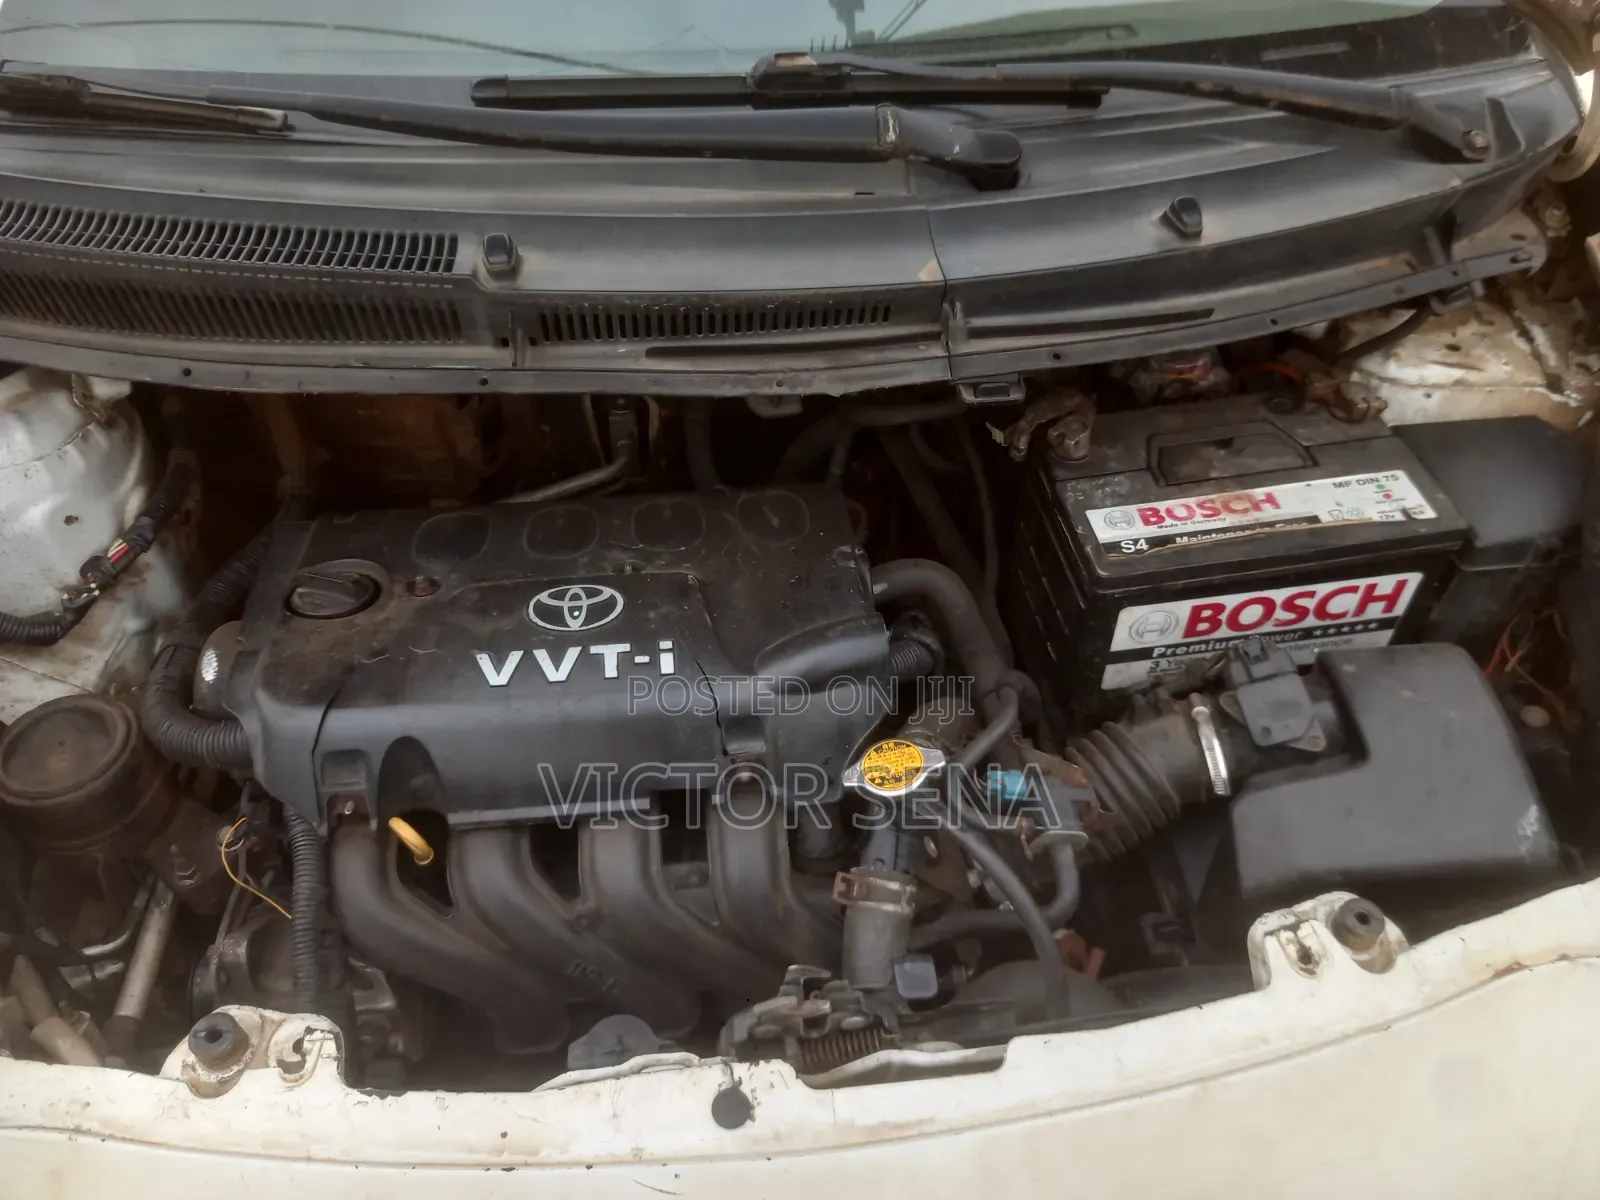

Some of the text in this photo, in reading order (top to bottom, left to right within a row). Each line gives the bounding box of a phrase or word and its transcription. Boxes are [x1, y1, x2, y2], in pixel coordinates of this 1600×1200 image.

[1356, 477, 1380, 486] DIN
[1382, 474, 1399, 482] 75
[1136, 491, 1281, 527] BOSCH
[1157, 522, 1179, 530] Made
[1190, 516, 1227, 527] Germany
[1120, 538, 1149, 553] S4
[1182, 579, 1409, 639] BOSCH
[475, 640, 676, 687] VVT-i
